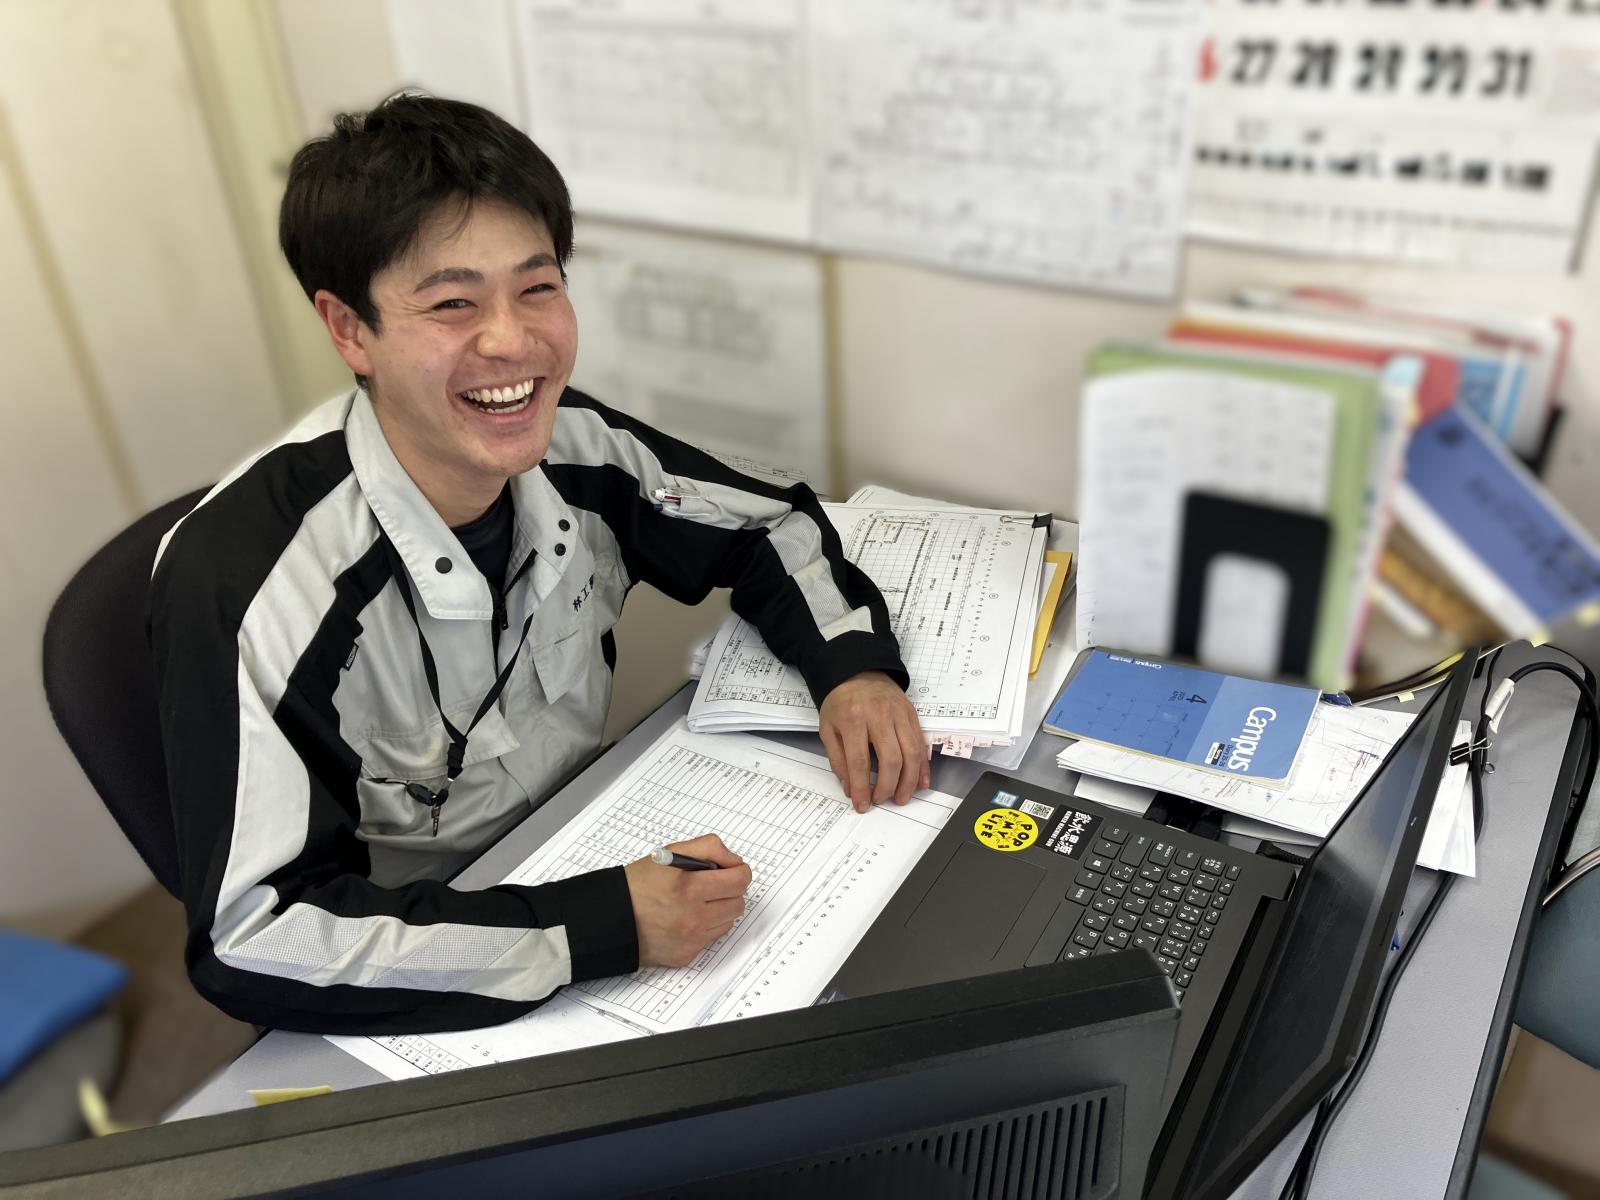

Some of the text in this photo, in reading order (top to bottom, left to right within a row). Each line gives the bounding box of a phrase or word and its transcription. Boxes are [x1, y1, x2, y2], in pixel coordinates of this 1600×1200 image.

[1231, 38, 1278, 85] 27
[1480, 46, 1533, 97] 31
[1186, 693, 1208, 704] 4
[1227, 706, 1277, 772] Campus
[980, 813, 1003, 839] LIFE
[998, 820, 1015, 839] MY
[1013, 823, 1033, 848] POP
[1053, 811, 1093, 856] 飲水思源
